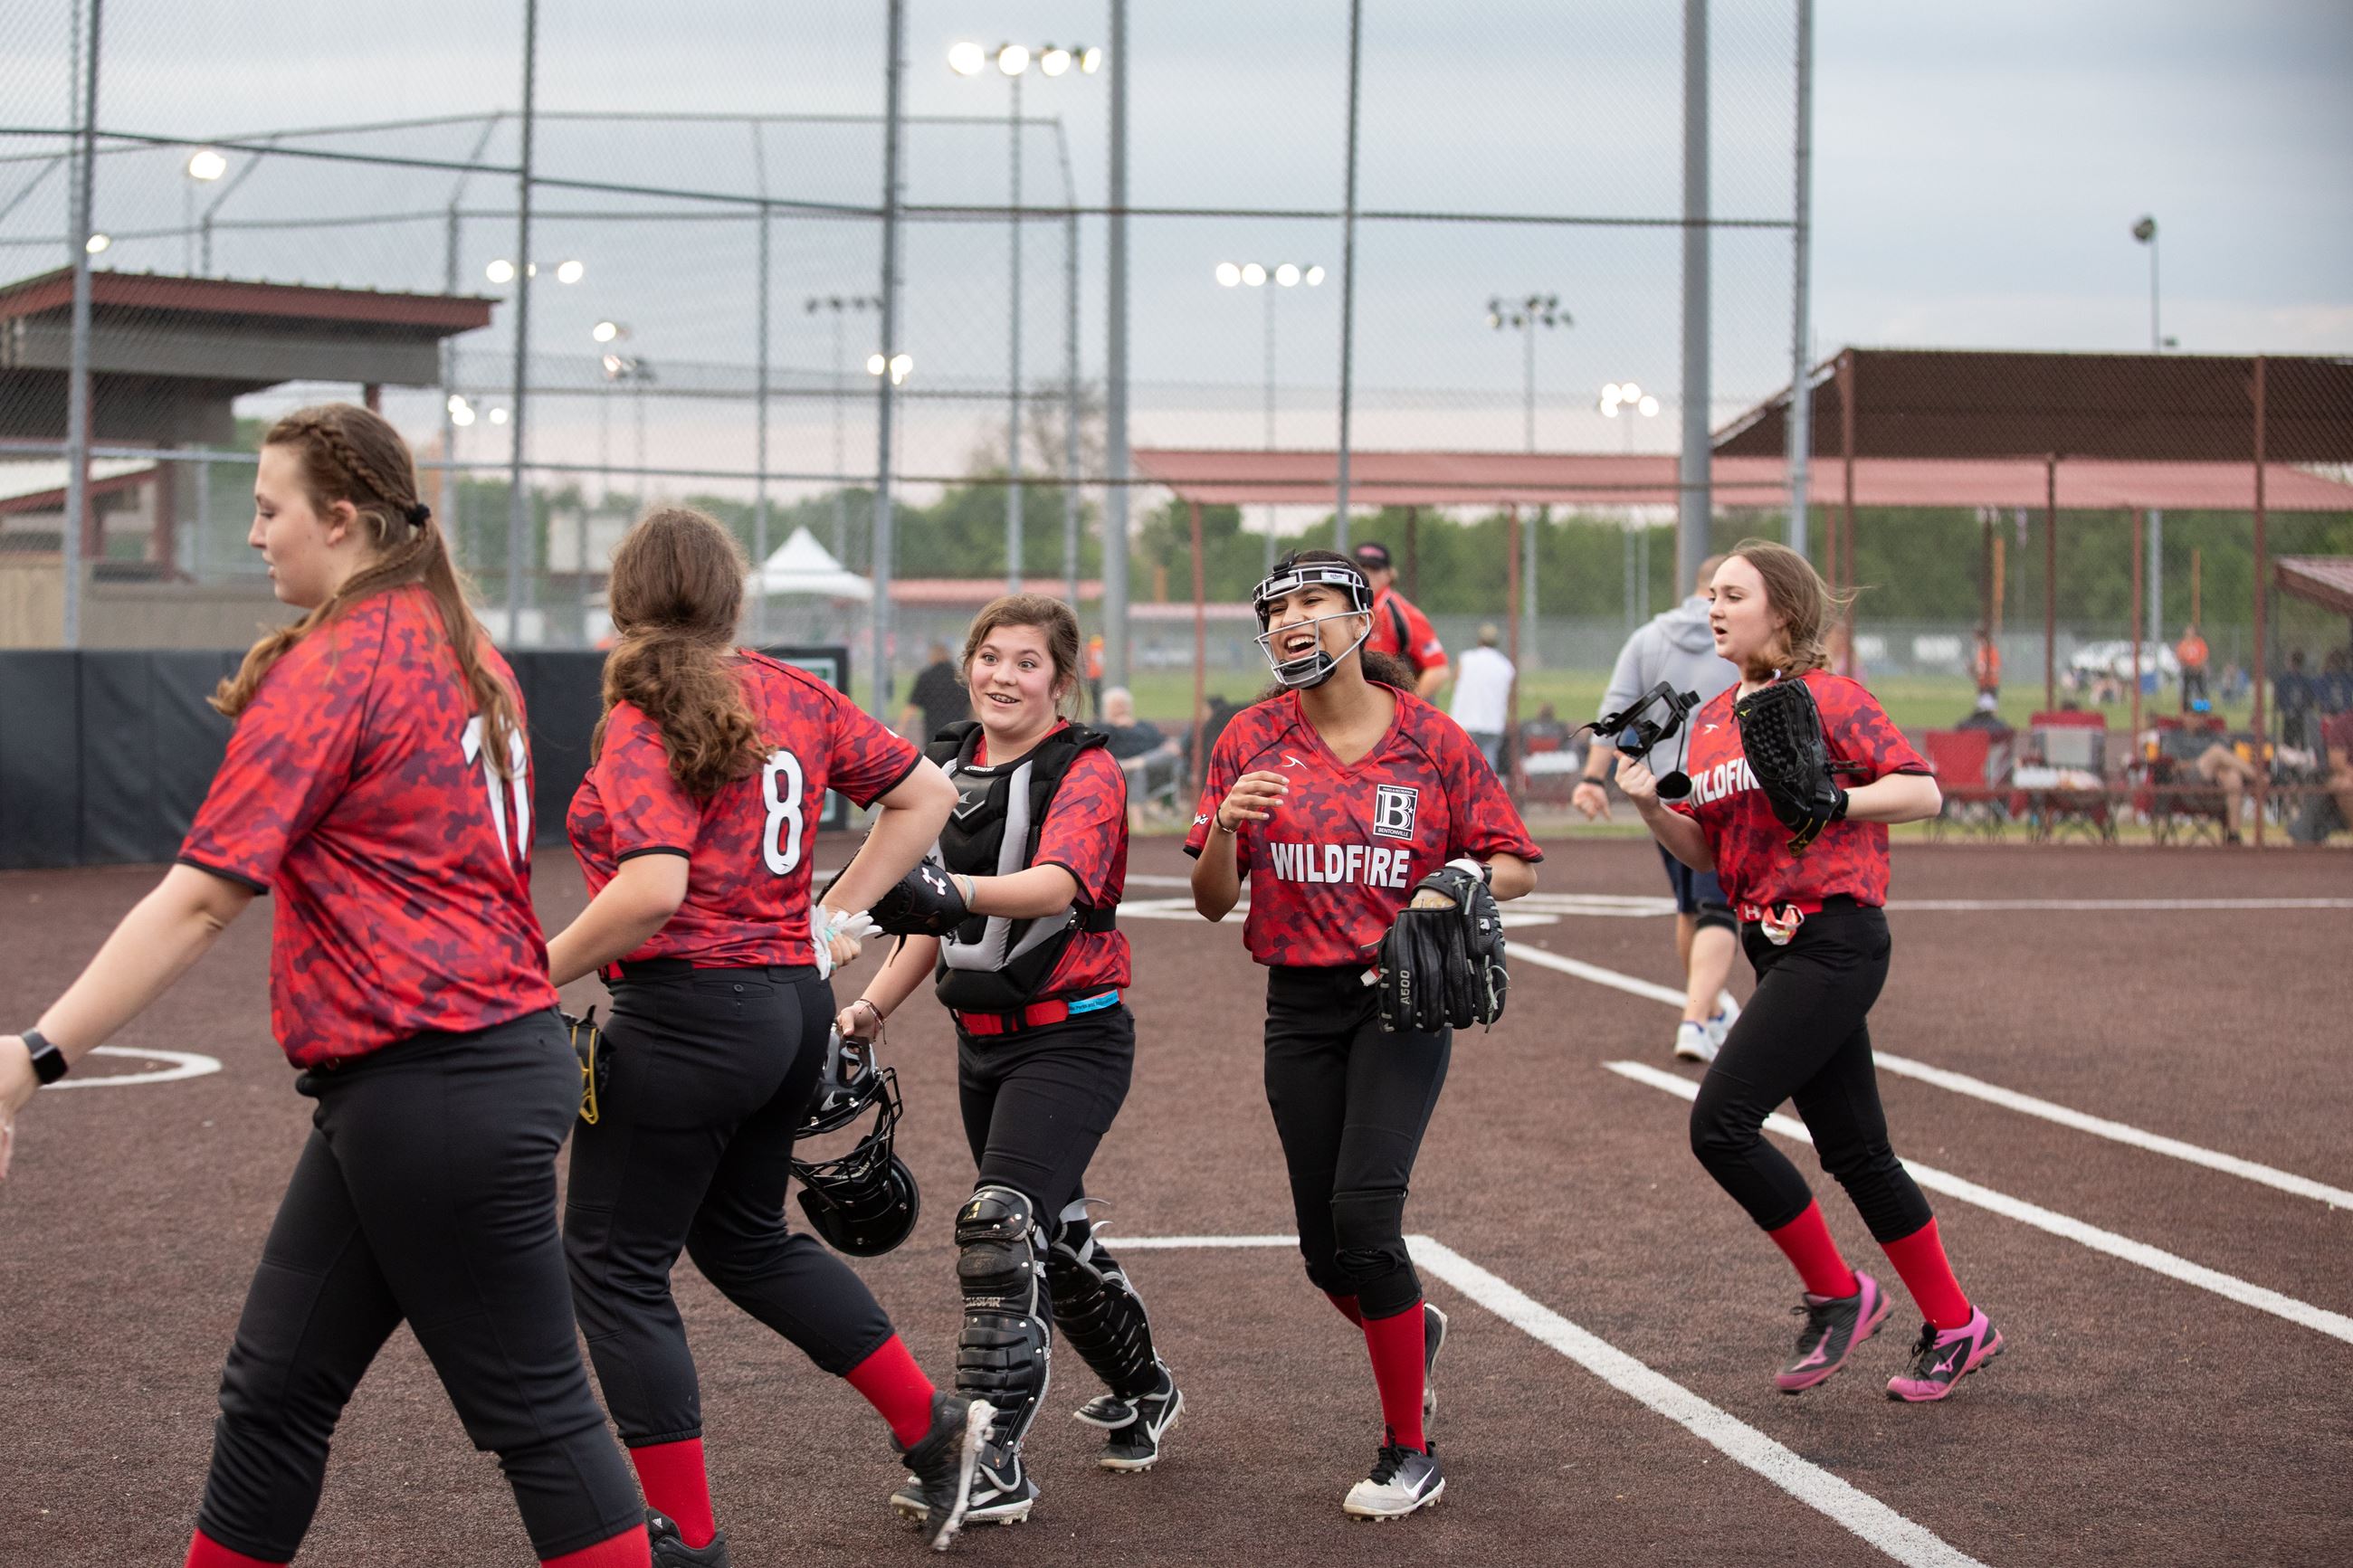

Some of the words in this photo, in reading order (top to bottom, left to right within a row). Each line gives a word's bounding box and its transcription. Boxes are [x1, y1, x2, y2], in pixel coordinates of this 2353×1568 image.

[763, 750, 804, 875] 8
[1381, 793, 1411, 829] B
[1377, 827, 1409, 838] BENTONVILLE
[1270, 842, 1410, 889] WILDFIRE
[1400, 970, 1410, 1005] A500
